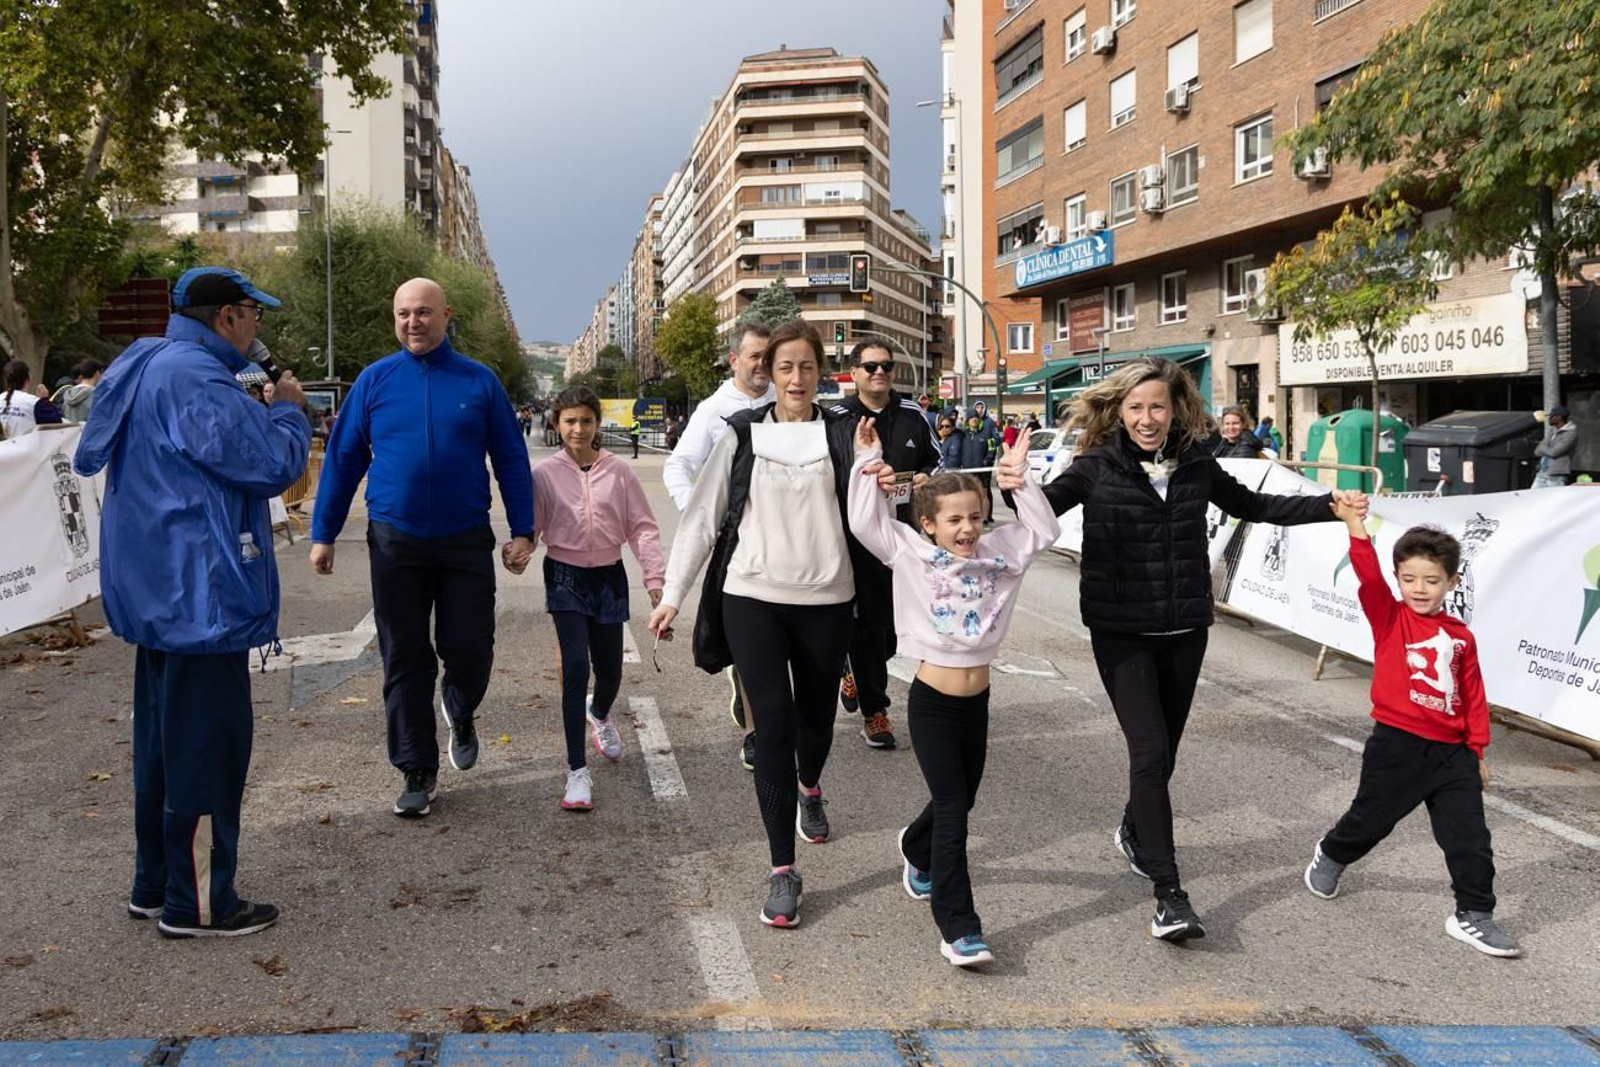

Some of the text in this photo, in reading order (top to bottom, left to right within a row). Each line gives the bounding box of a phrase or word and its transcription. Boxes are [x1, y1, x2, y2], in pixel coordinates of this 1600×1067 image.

[1058, 241, 1094, 264] DENTAL
[1291, 344, 1313, 363] 958
[1317, 342, 1340, 361] 650
[1401, 334, 1429, 354] 603
[1435, 330, 1466, 352] 045
[1471, 325, 1504, 349] 046
[1326, 365, 1372, 379] DISPONIBLE
[0, 564, 36, 584] nicipal de
[3, 587, 13, 599] de
[1335, 609, 1344, 619] de
[1518, 639, 1565, 663] Patronato
[1528, 660, 1566, 682] Deportes
[1567, 672, 1584, 687] de
